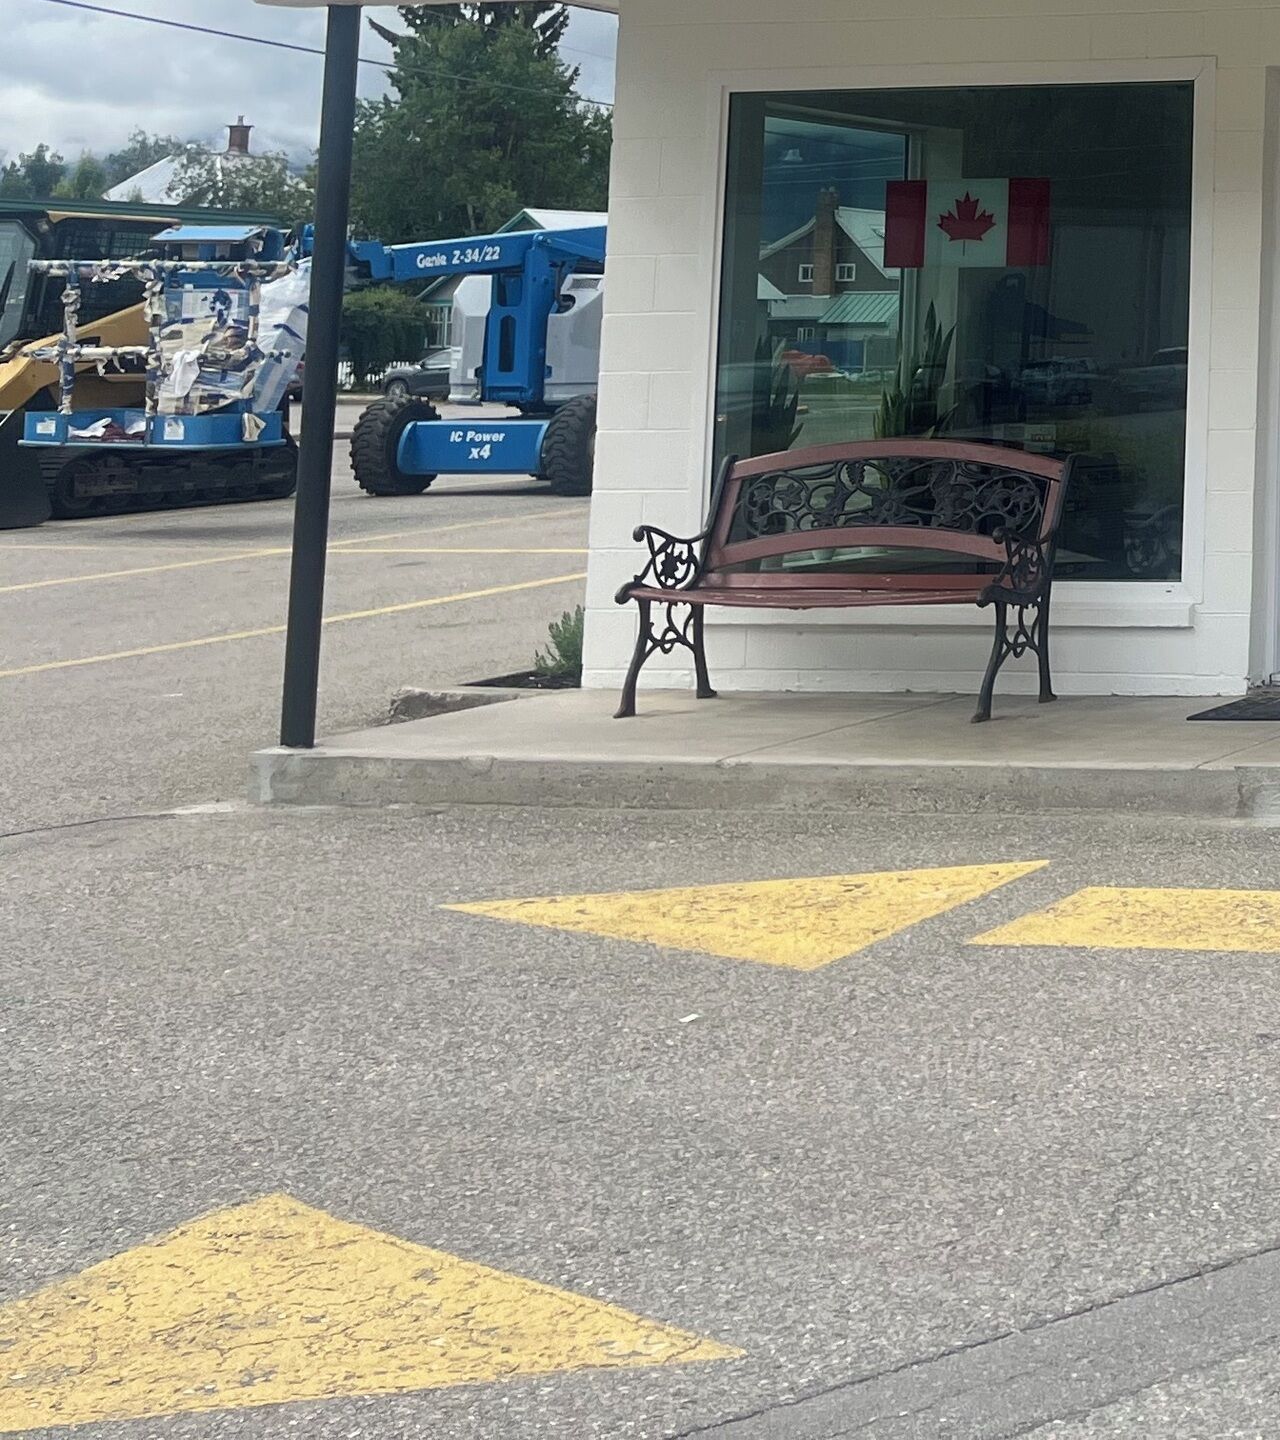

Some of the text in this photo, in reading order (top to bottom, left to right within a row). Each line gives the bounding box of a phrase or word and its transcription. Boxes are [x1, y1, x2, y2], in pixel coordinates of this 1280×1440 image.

[416, 244, 501, 269] Genie Z-34/22
[449, 430, 506, 443] IC Power
[468, 443, 492, 460] x4
